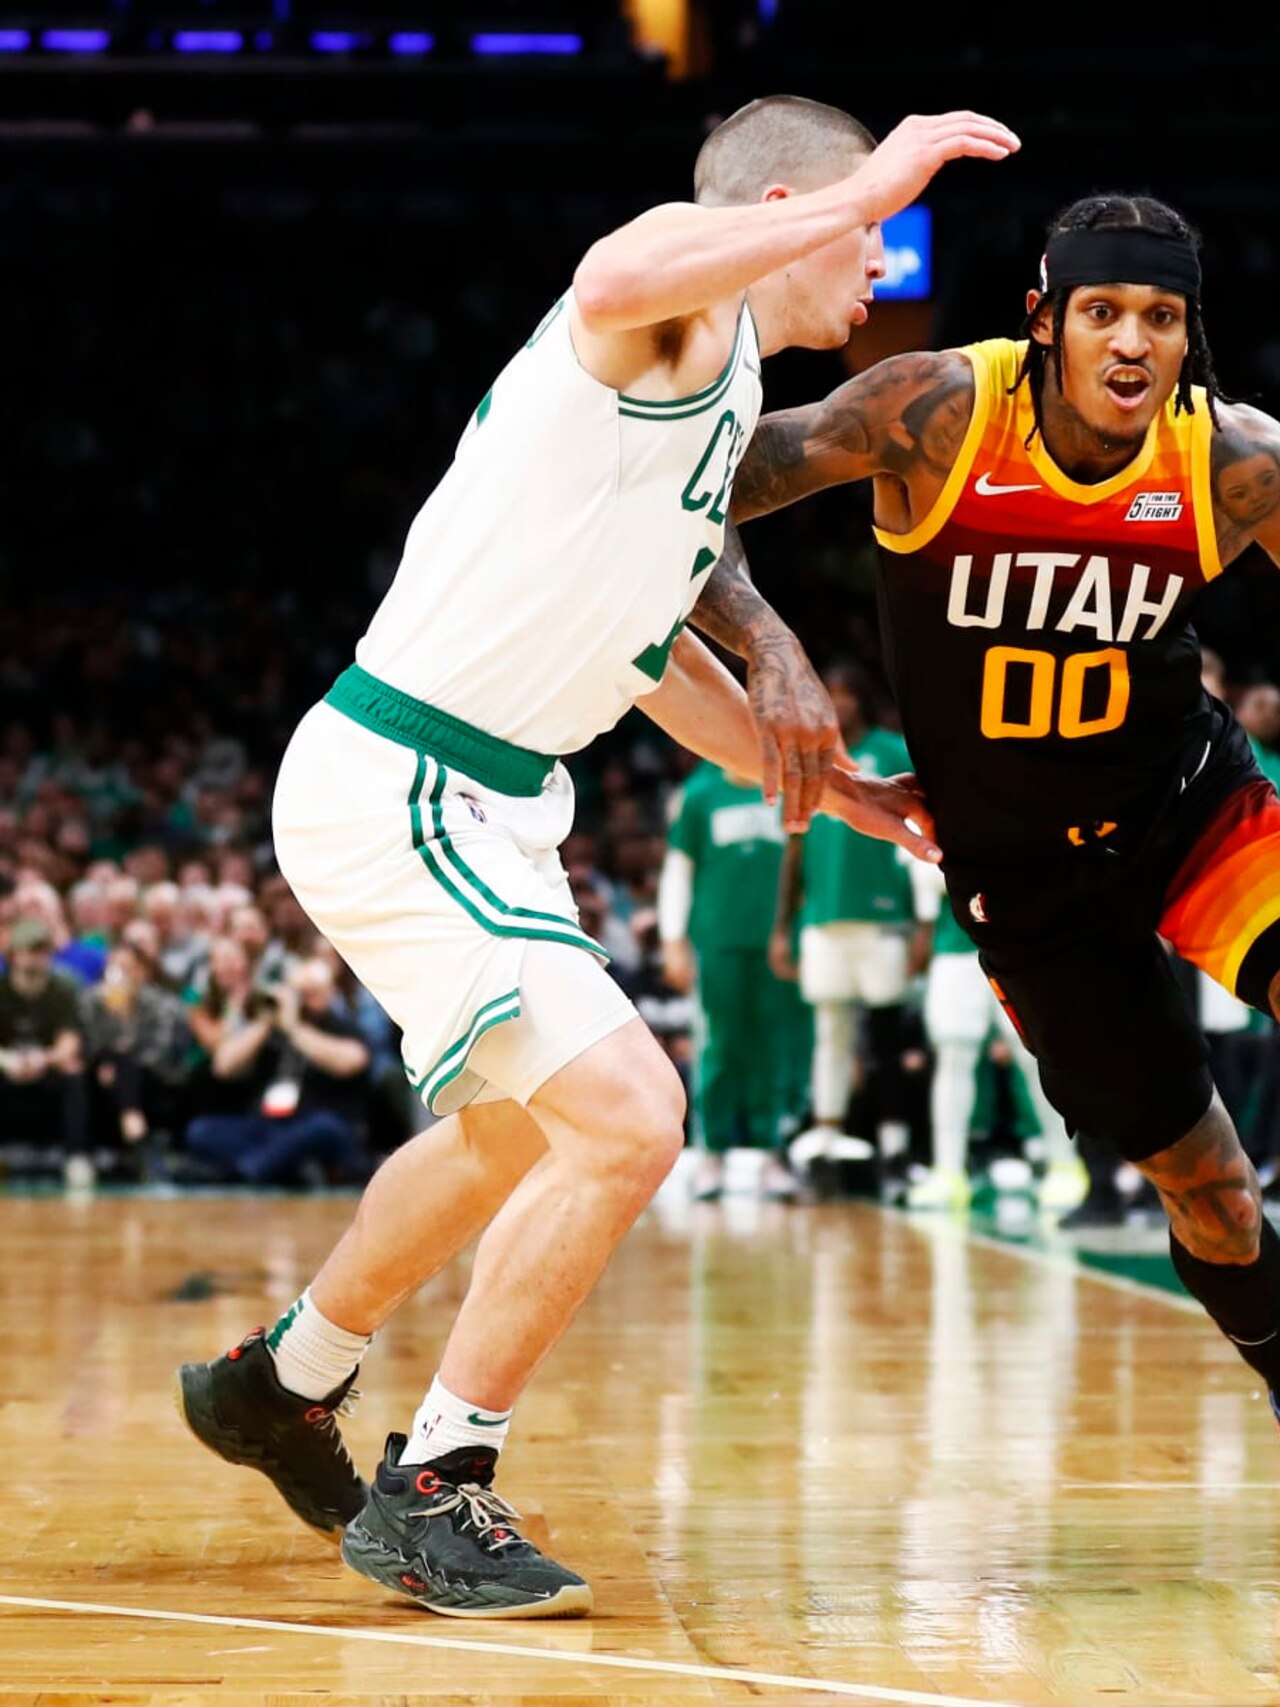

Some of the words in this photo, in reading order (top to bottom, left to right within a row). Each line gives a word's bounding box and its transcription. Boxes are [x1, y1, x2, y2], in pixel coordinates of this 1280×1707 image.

[1129, 495, 1146, 519] 5
[1144, 507, 1179, 518] FIGHT
[947, 552, 1184, 642] UTAH
[980, 646, 1130, 739] 00
